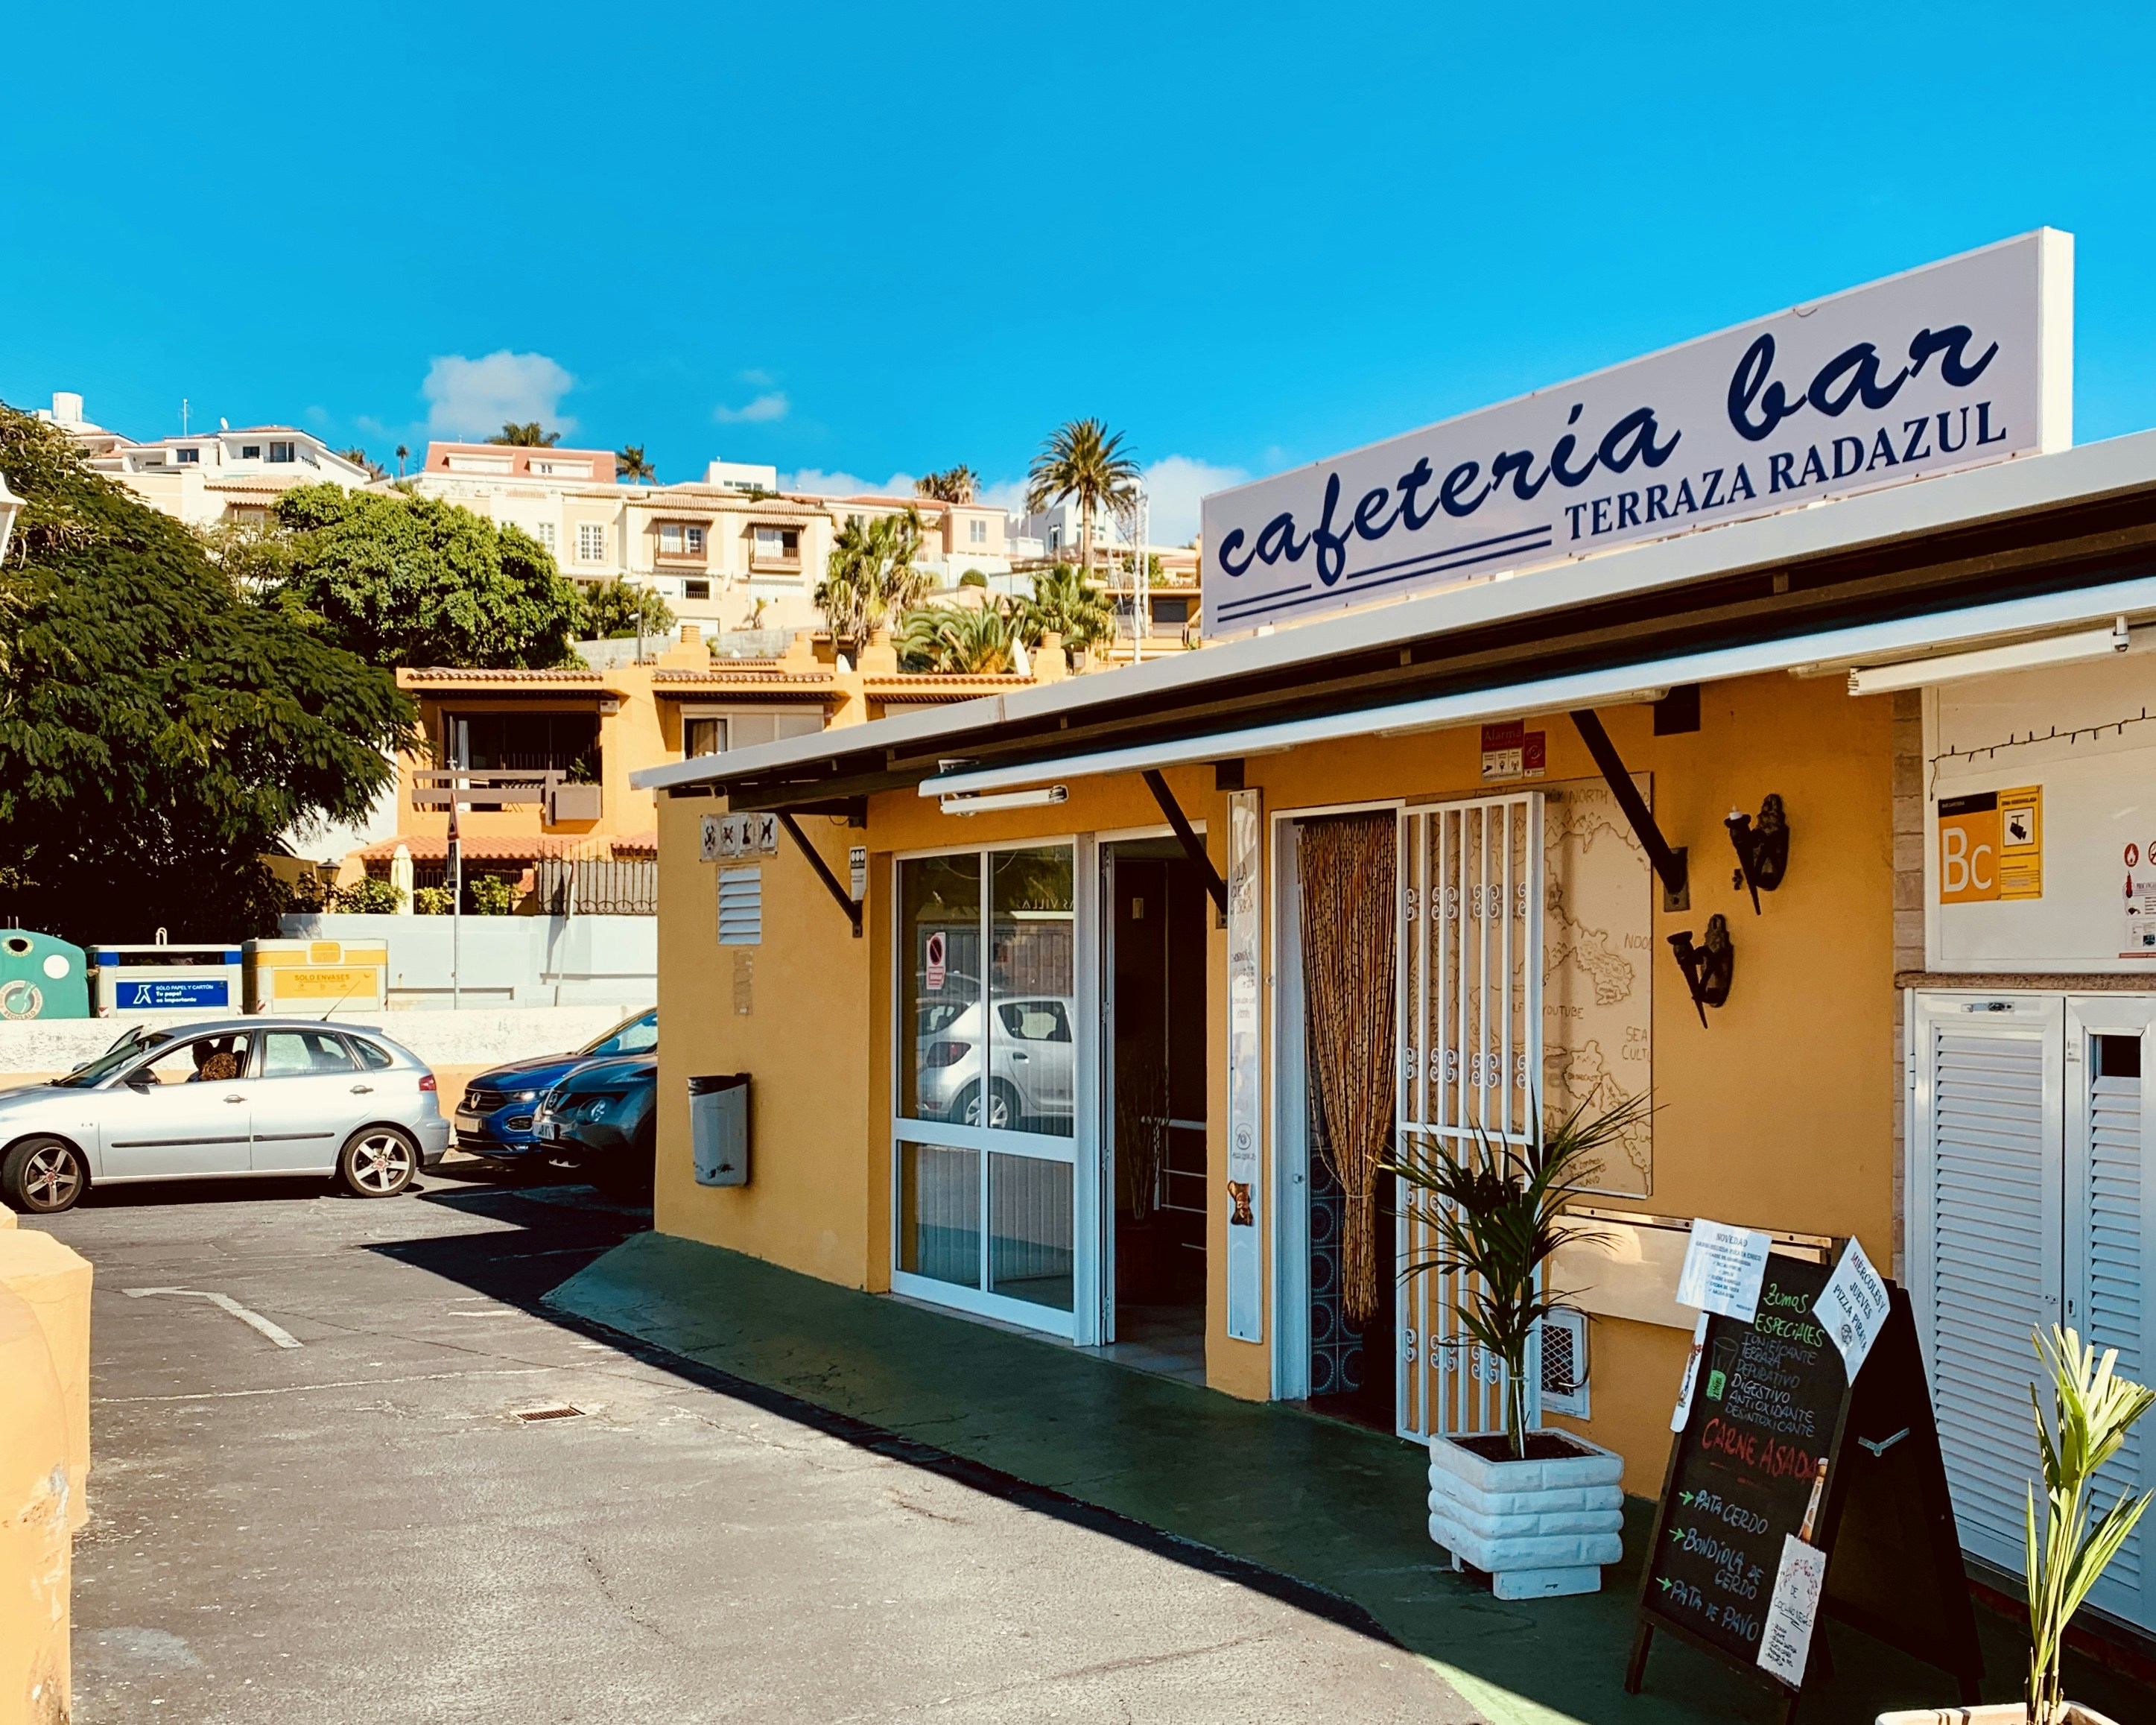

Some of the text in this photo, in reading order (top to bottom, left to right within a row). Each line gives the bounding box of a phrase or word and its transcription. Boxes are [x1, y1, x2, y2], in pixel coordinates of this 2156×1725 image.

[1218, 323, 1999, 584] cafetería bar
[1564, 399, 2008, 540] TERRAZA RADAZUL
[1484, 729, 1522, 741] Alarma
[1568, 789, 1608, 805] NORTH
[1626, 1025, 1648, 1042] SEA
[1716, 1232, 1748, 1247] NOVEDAD
[1833, 1283, 1852, 1318] PIZZA
[1849, 1282, 1873, 1320] JUEVES
[1702, 1417, 1757, 1466] CARNE
[1693, 1490, 1769, 1535] PATA CERDO
[1714, 1569, 1757, 1600] CERDO
[1747, 1565, 1765, 1586] DE
[1670, 1580, 1760, 1642] PATA DE PAVO
